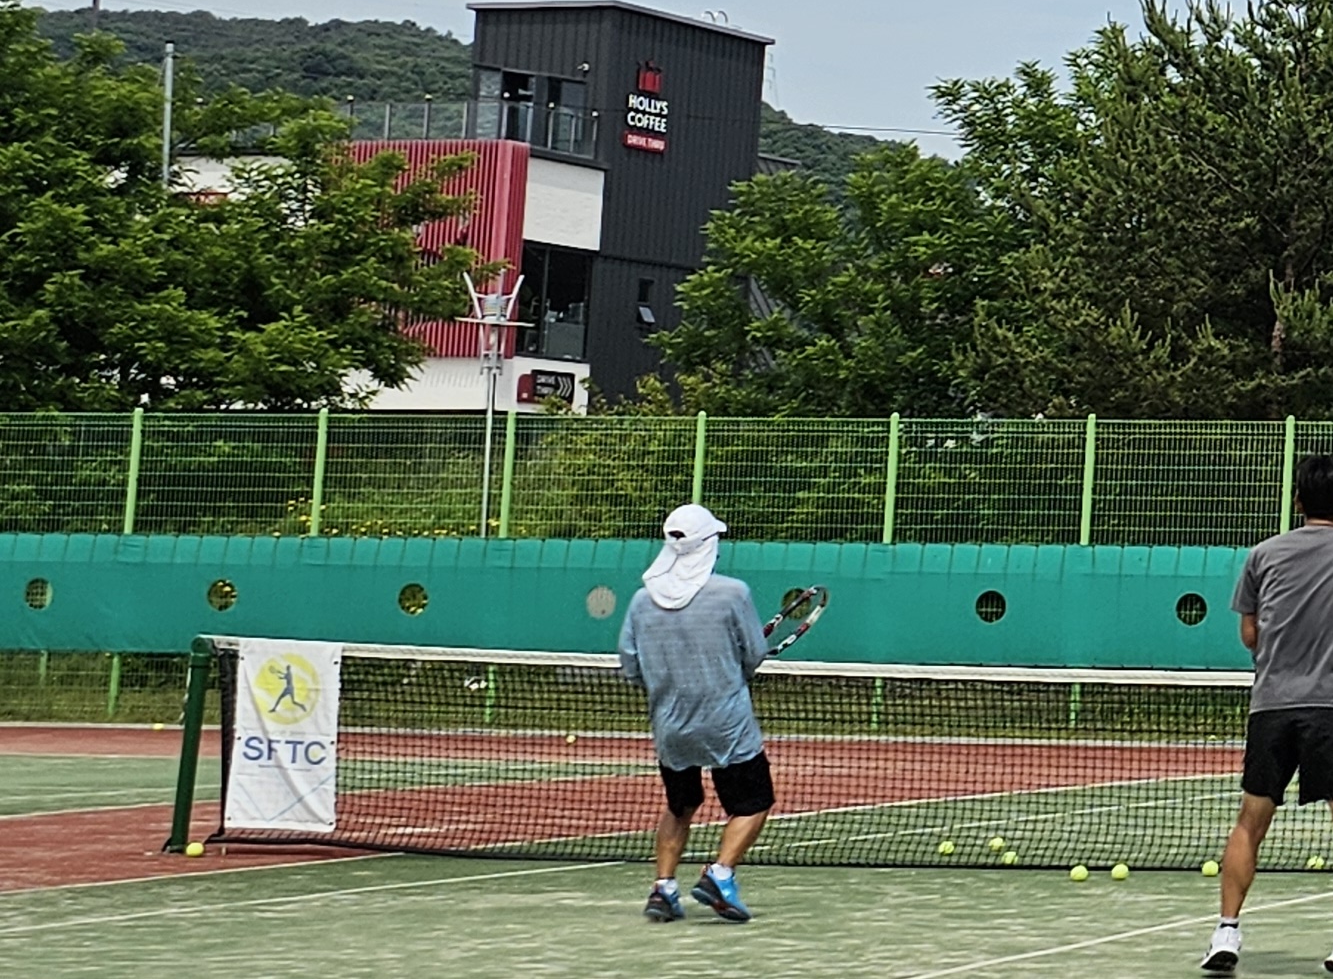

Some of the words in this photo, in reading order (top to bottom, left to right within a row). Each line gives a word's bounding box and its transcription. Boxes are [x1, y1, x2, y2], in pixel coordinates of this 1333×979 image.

[628, 94, 668, 115] HOLLYS
[627, 111, 667, 132] COFFEE
[242, 736, 327, 765] SFTC
